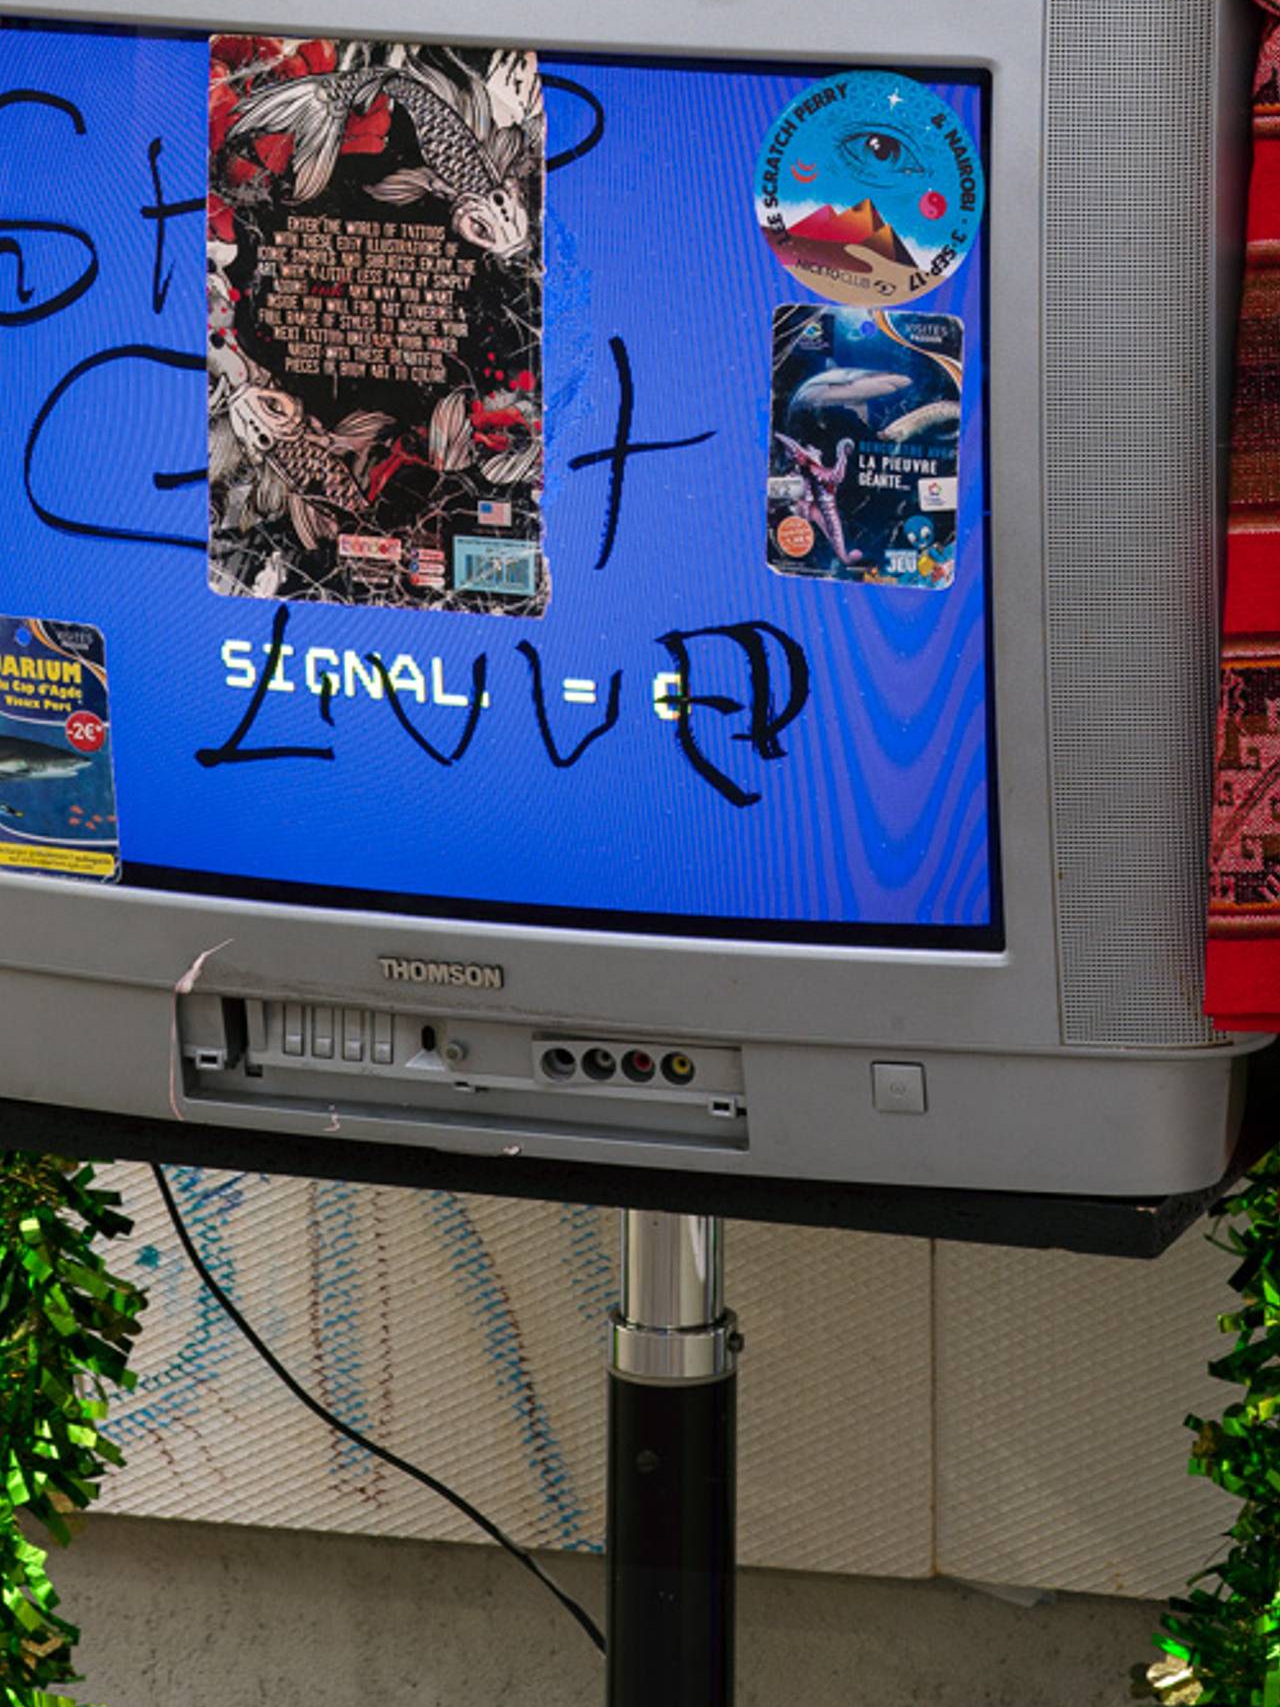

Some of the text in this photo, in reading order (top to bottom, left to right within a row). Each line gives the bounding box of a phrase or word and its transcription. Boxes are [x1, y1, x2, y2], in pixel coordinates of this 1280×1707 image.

[761, 118, 798, 209] SCRATCH
[794, 82, 848, 122] PERRY
[943, 128, 976, 212] NAIROBI
[859, 454, 938, 475] LA PIEUVRE
[12, 680, 36, 696] Cap
[38, 684, 82, 699] d'Agde
[4, 695, 72, 712] Vieux Port
[379, 956, 503, 990] THOMSON
